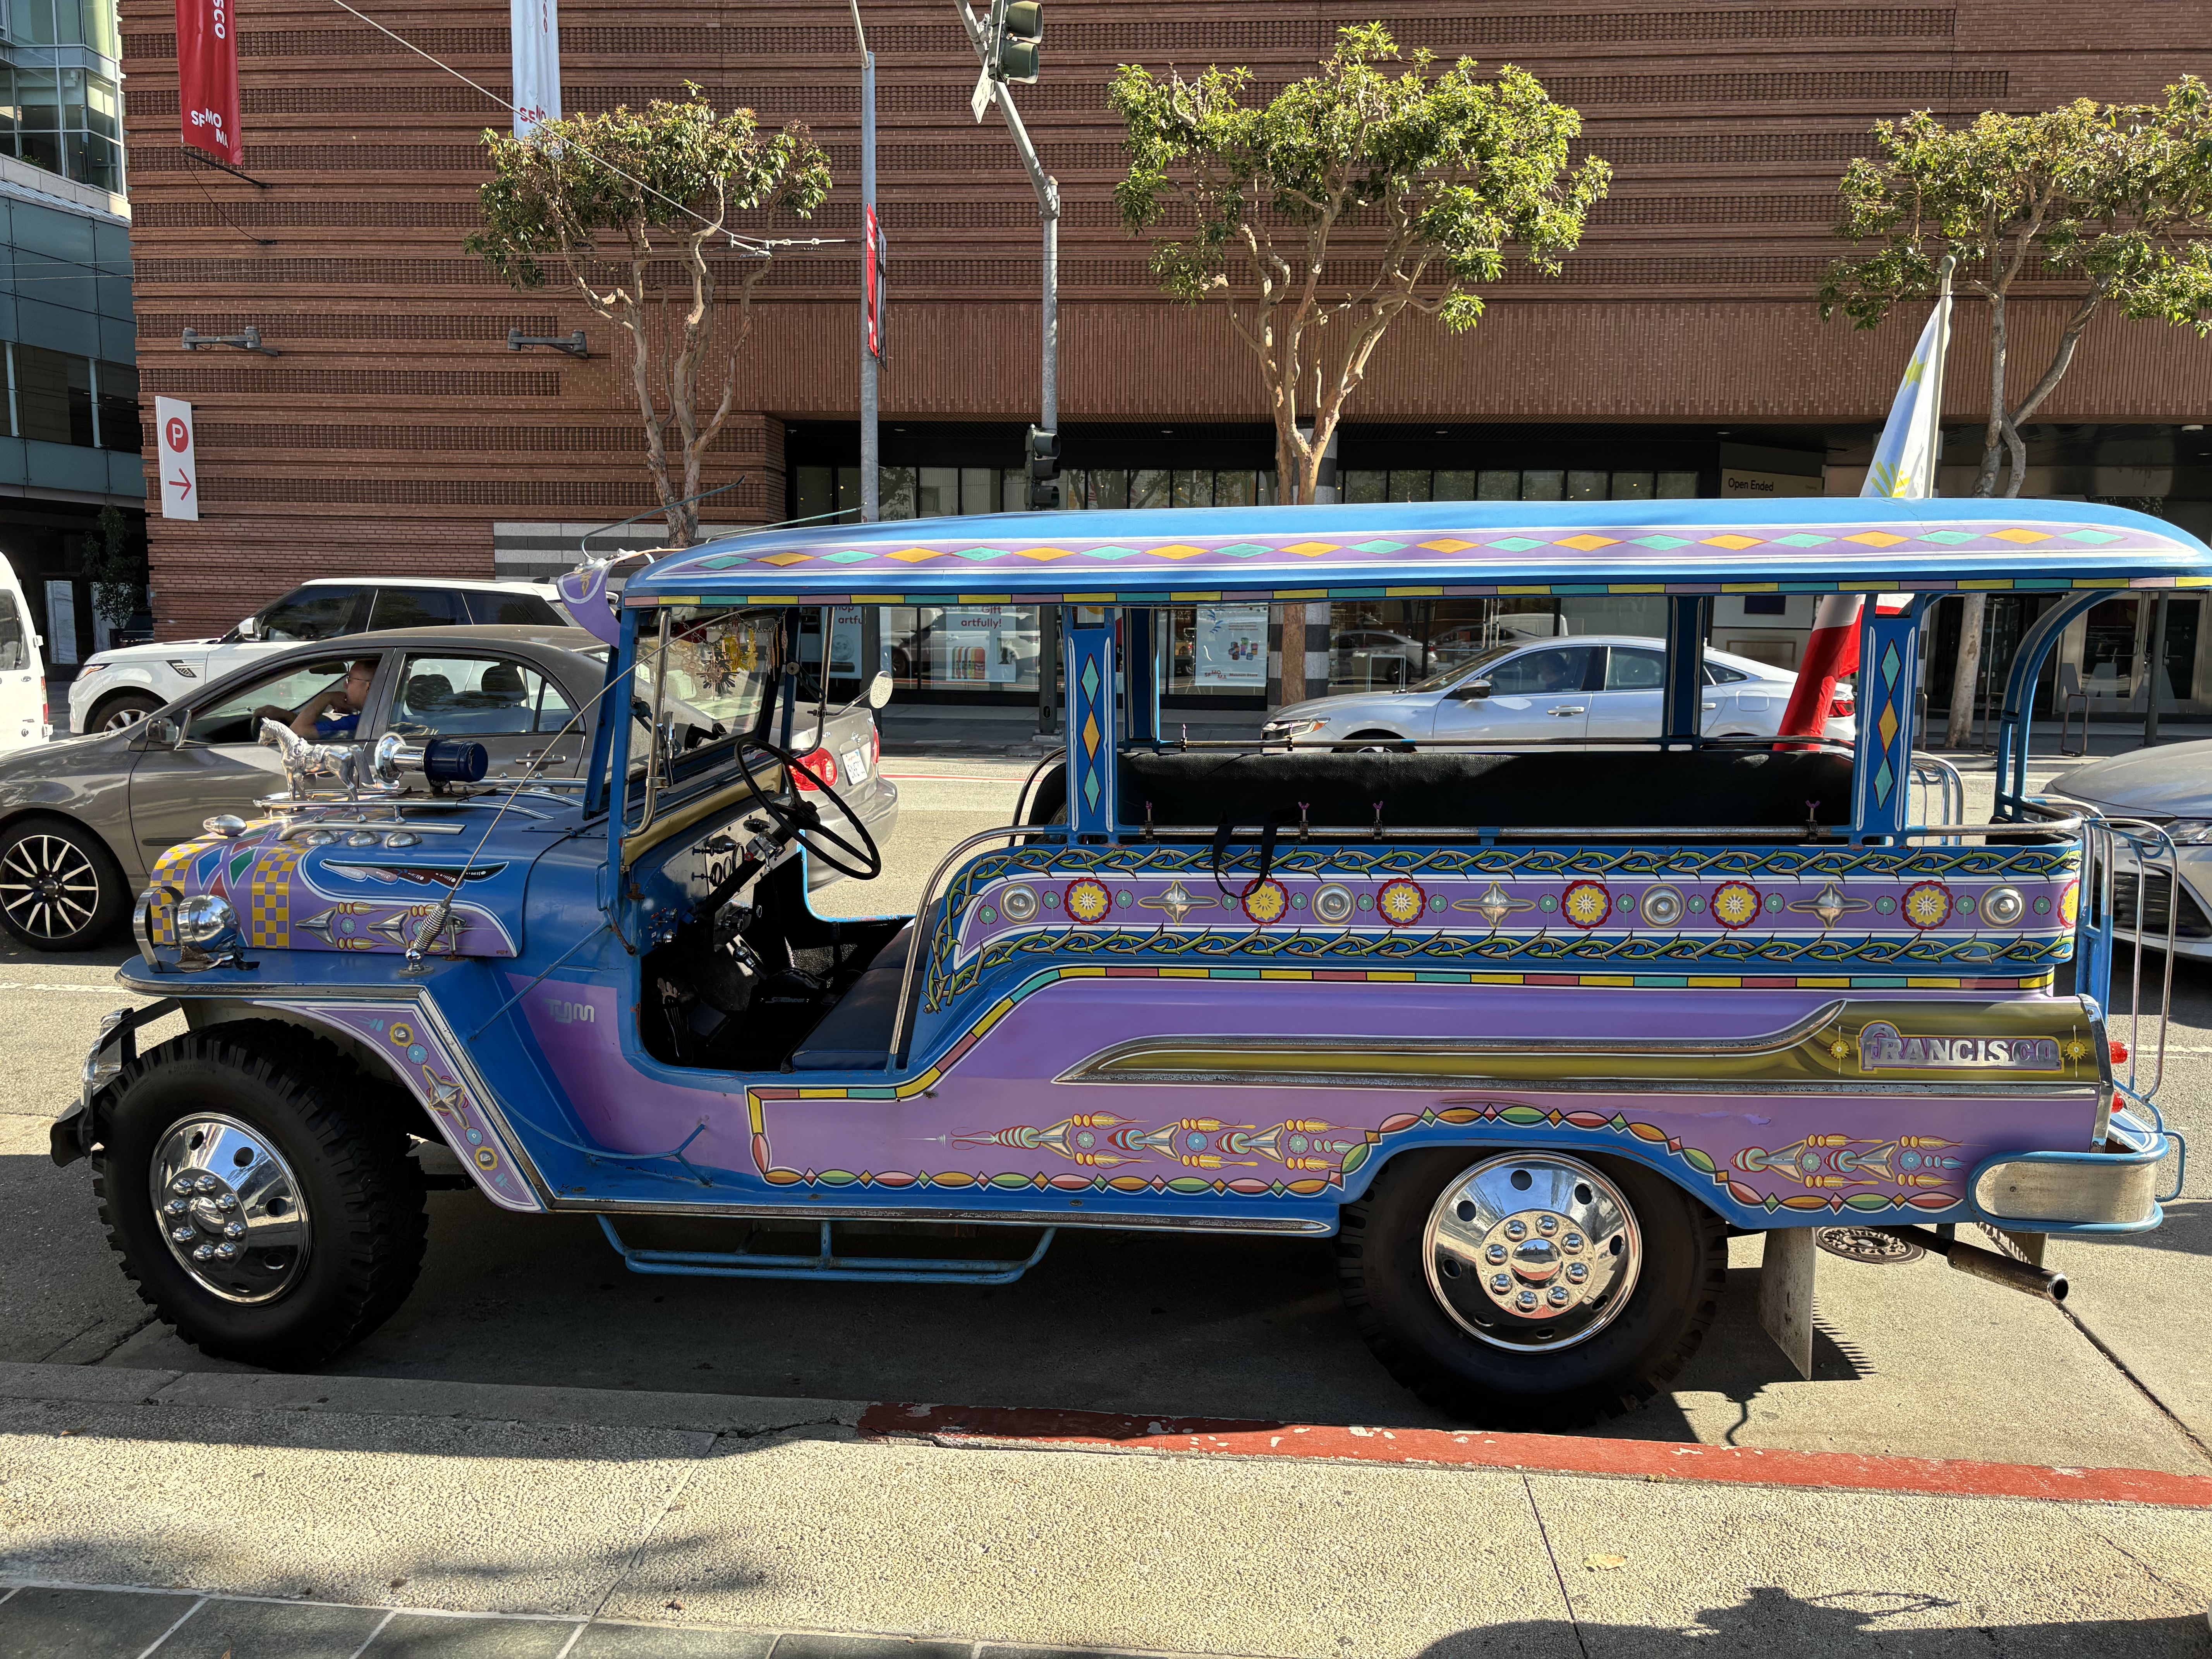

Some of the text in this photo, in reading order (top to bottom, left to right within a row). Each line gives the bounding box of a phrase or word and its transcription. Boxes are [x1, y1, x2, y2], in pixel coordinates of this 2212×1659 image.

[172, 424, 184, 446] P
[1728, 477, 1774, 491] Open Ended
[961, 618, 1001, 629] artfully!
[1859, 1024, 2061, 1070] FRANCISCO
